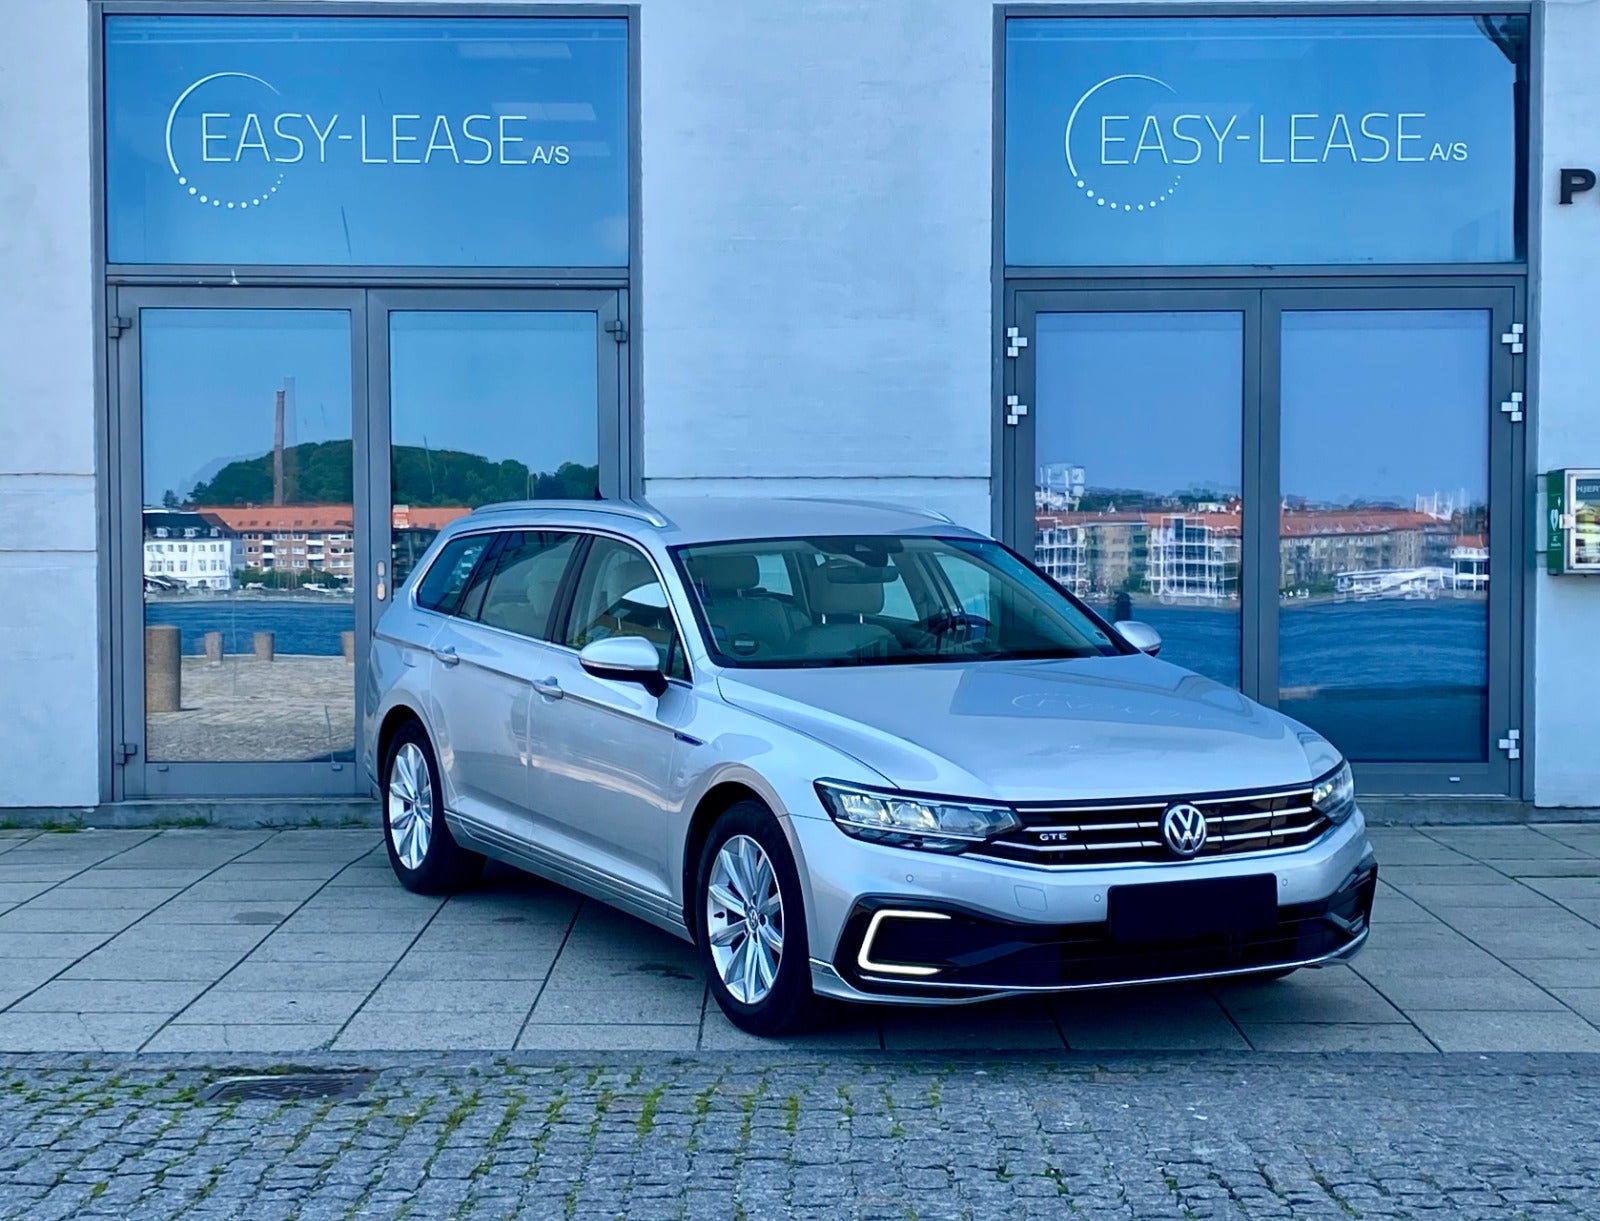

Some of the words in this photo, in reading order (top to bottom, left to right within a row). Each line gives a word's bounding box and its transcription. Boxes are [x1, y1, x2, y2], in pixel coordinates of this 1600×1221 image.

[202, 113, 528, 165] EASY-LEASE
[531, 145, 570, 165] A/S
[1101, 112, 1426, 165] EASY-LEASE
[1429, 142, 1468, 162] A/S
[1558, 168, 1597, 205] P
[1039, 832, 1068, 842] GTE
